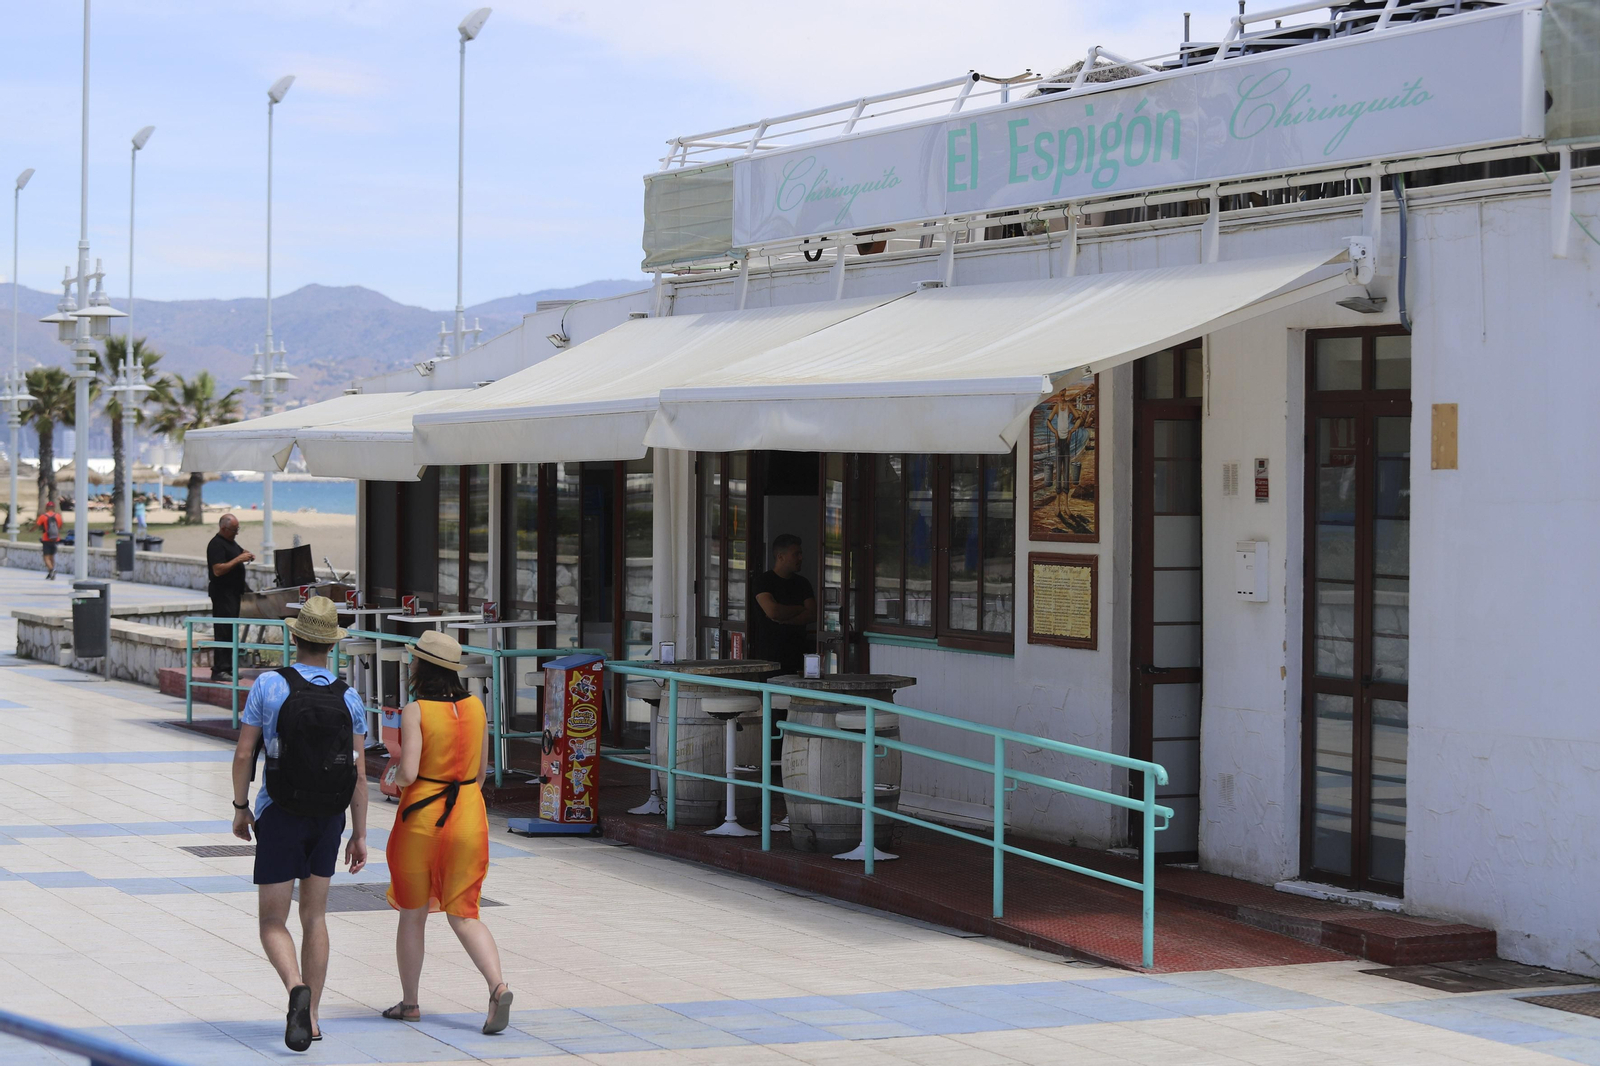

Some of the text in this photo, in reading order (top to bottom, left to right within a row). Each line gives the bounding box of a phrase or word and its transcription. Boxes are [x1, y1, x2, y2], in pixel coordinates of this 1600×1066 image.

[947, 98, 1182, 195] El Espigón
[1229, 67, 1434, 156] Chiringuito
[776, 156, 902, 226] Chiringuito
